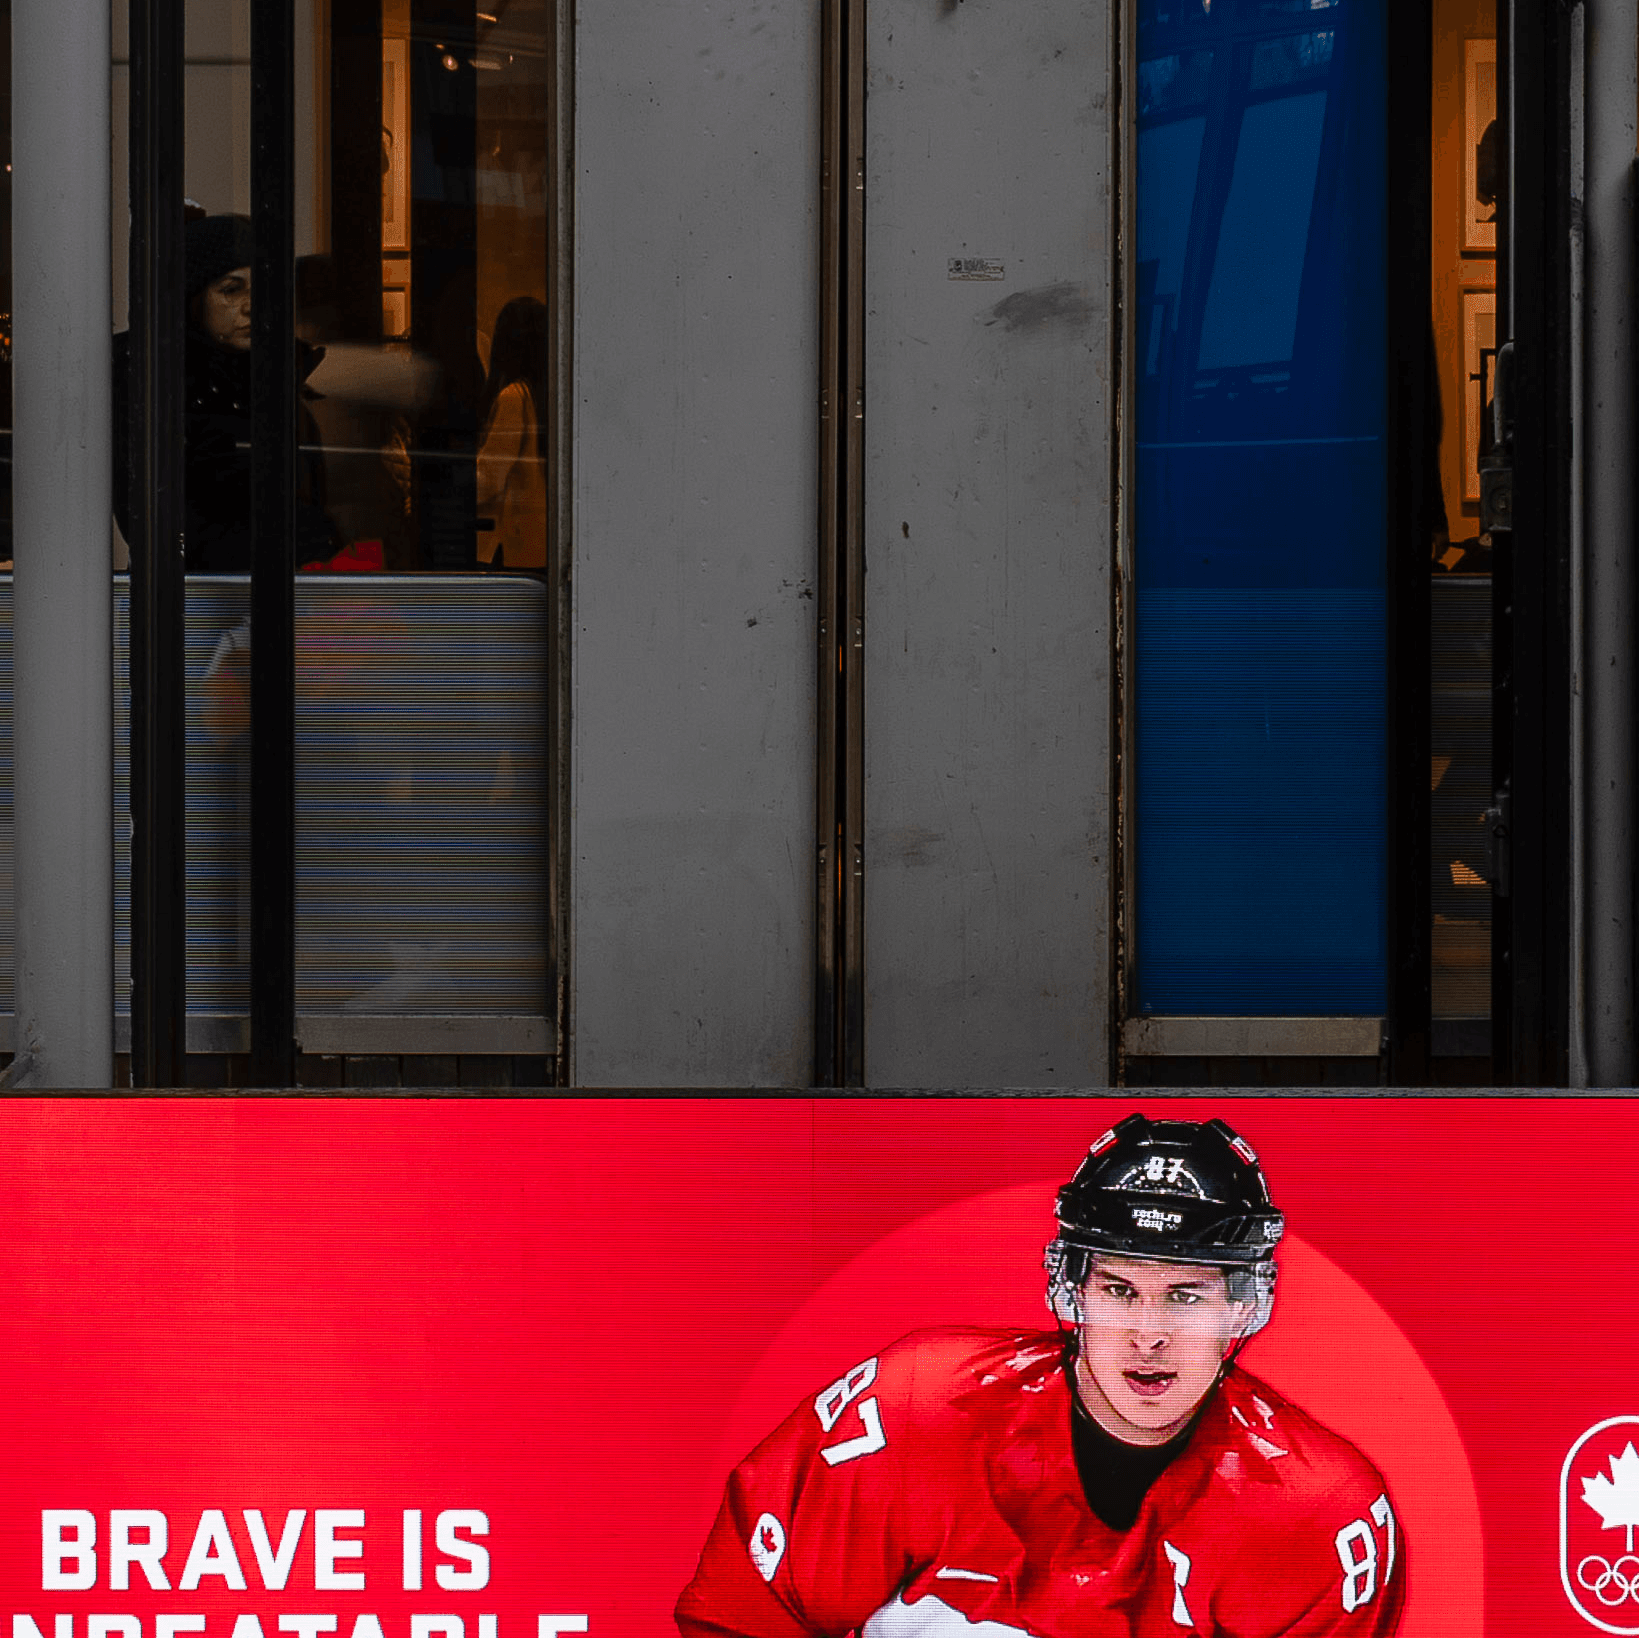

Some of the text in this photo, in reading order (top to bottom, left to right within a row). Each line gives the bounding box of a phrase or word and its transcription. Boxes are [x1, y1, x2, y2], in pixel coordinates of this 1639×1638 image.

[1147, 1156, 1185, 1183] 87
[814, 1356, 888, 1467] 87
[40, 1508, 492, 1592] BRAVE IS
[1335, 1493, 1396, 1613] 87
